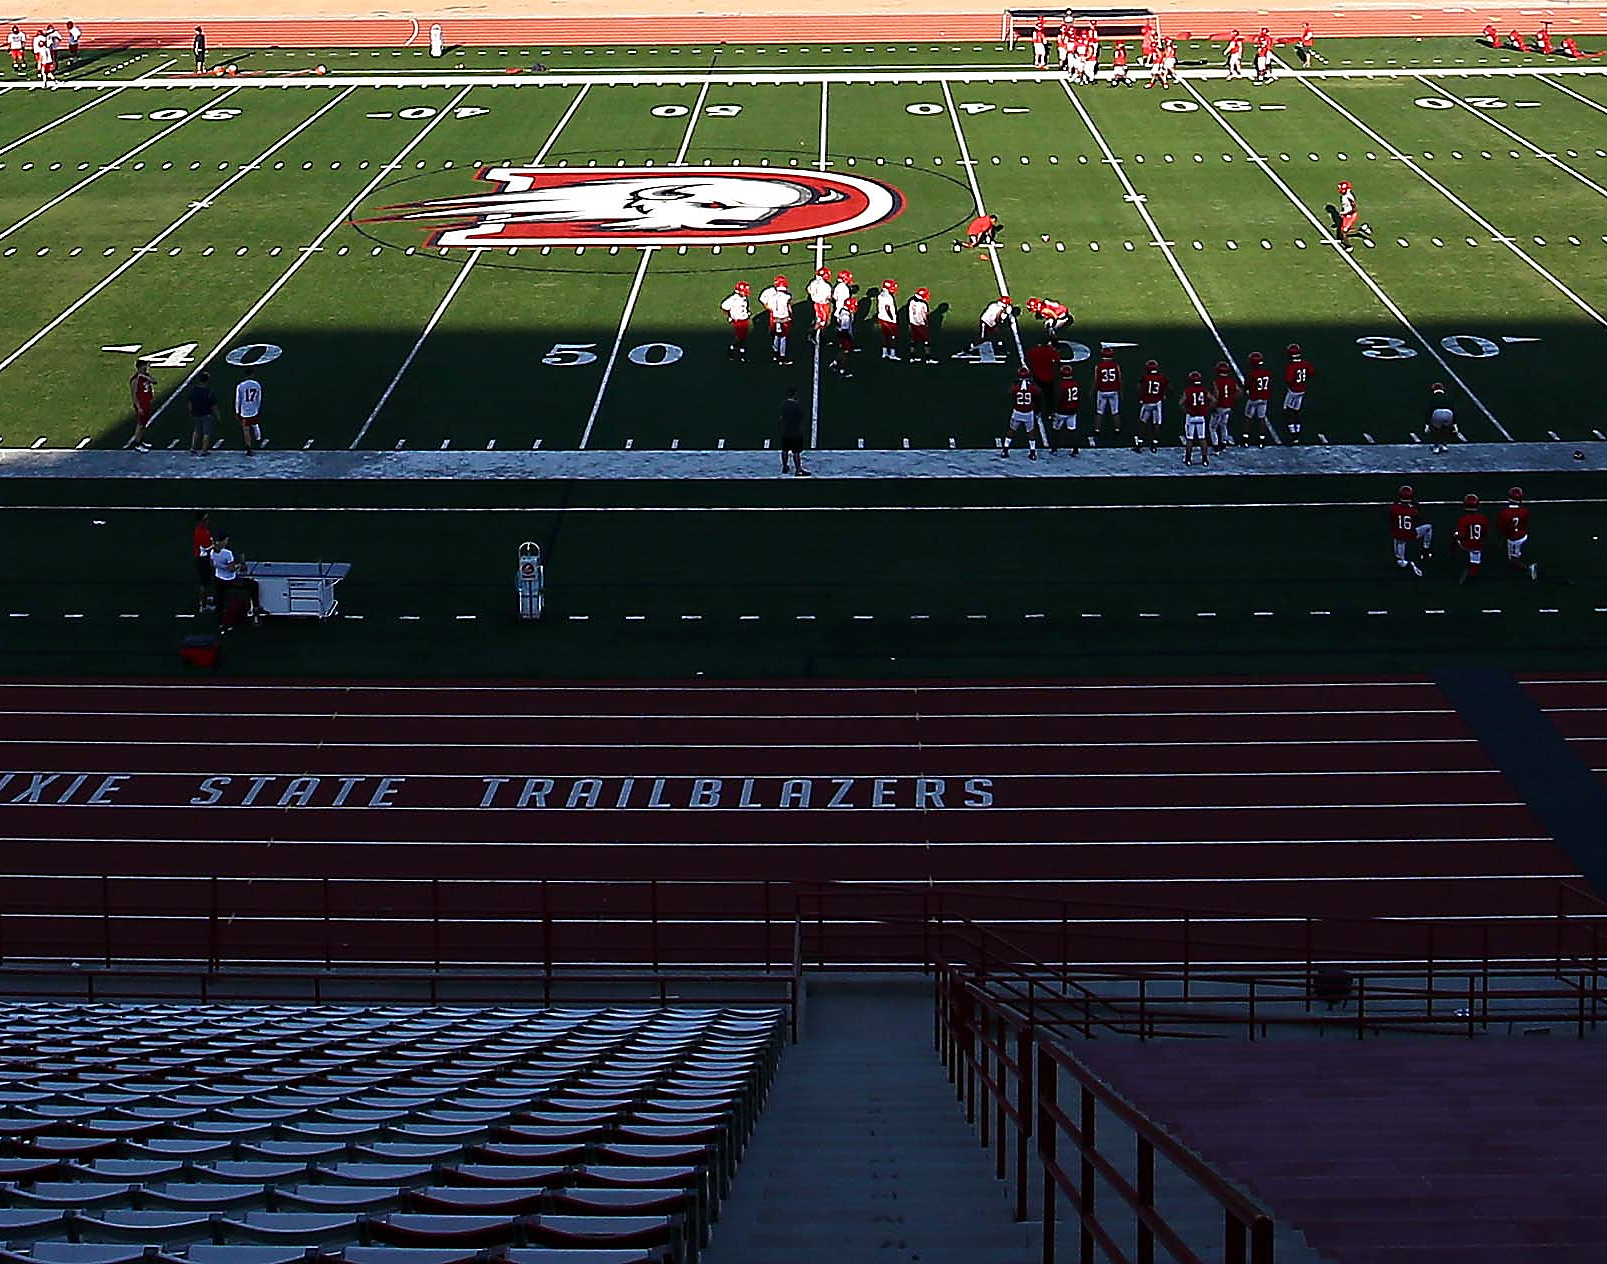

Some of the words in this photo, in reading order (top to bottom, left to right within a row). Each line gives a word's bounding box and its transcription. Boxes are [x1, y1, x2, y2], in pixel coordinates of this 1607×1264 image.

[137, 341, 284, 369] 40
[541, 342, 685, 368] 50
[1356, 334, 1502, 361] 30
[1100, 367, 1117, 383] 35
[1147, 381, 1160, 395] 13
[1256, 376, 1270, 391] 37
[245, 388, 258, 403] 17
[1016, 392, 1032, 405] 29
[1067, 386, 1079, 402] 12
[1191, 392, 1205, 406] 14
[1398, 515, 1412, 530] 16
[1469, 524, 1482, 540] 19
[189, 774, 407, 808] STATE
[478, 776, 997, 810] TRAILBLAZERS
